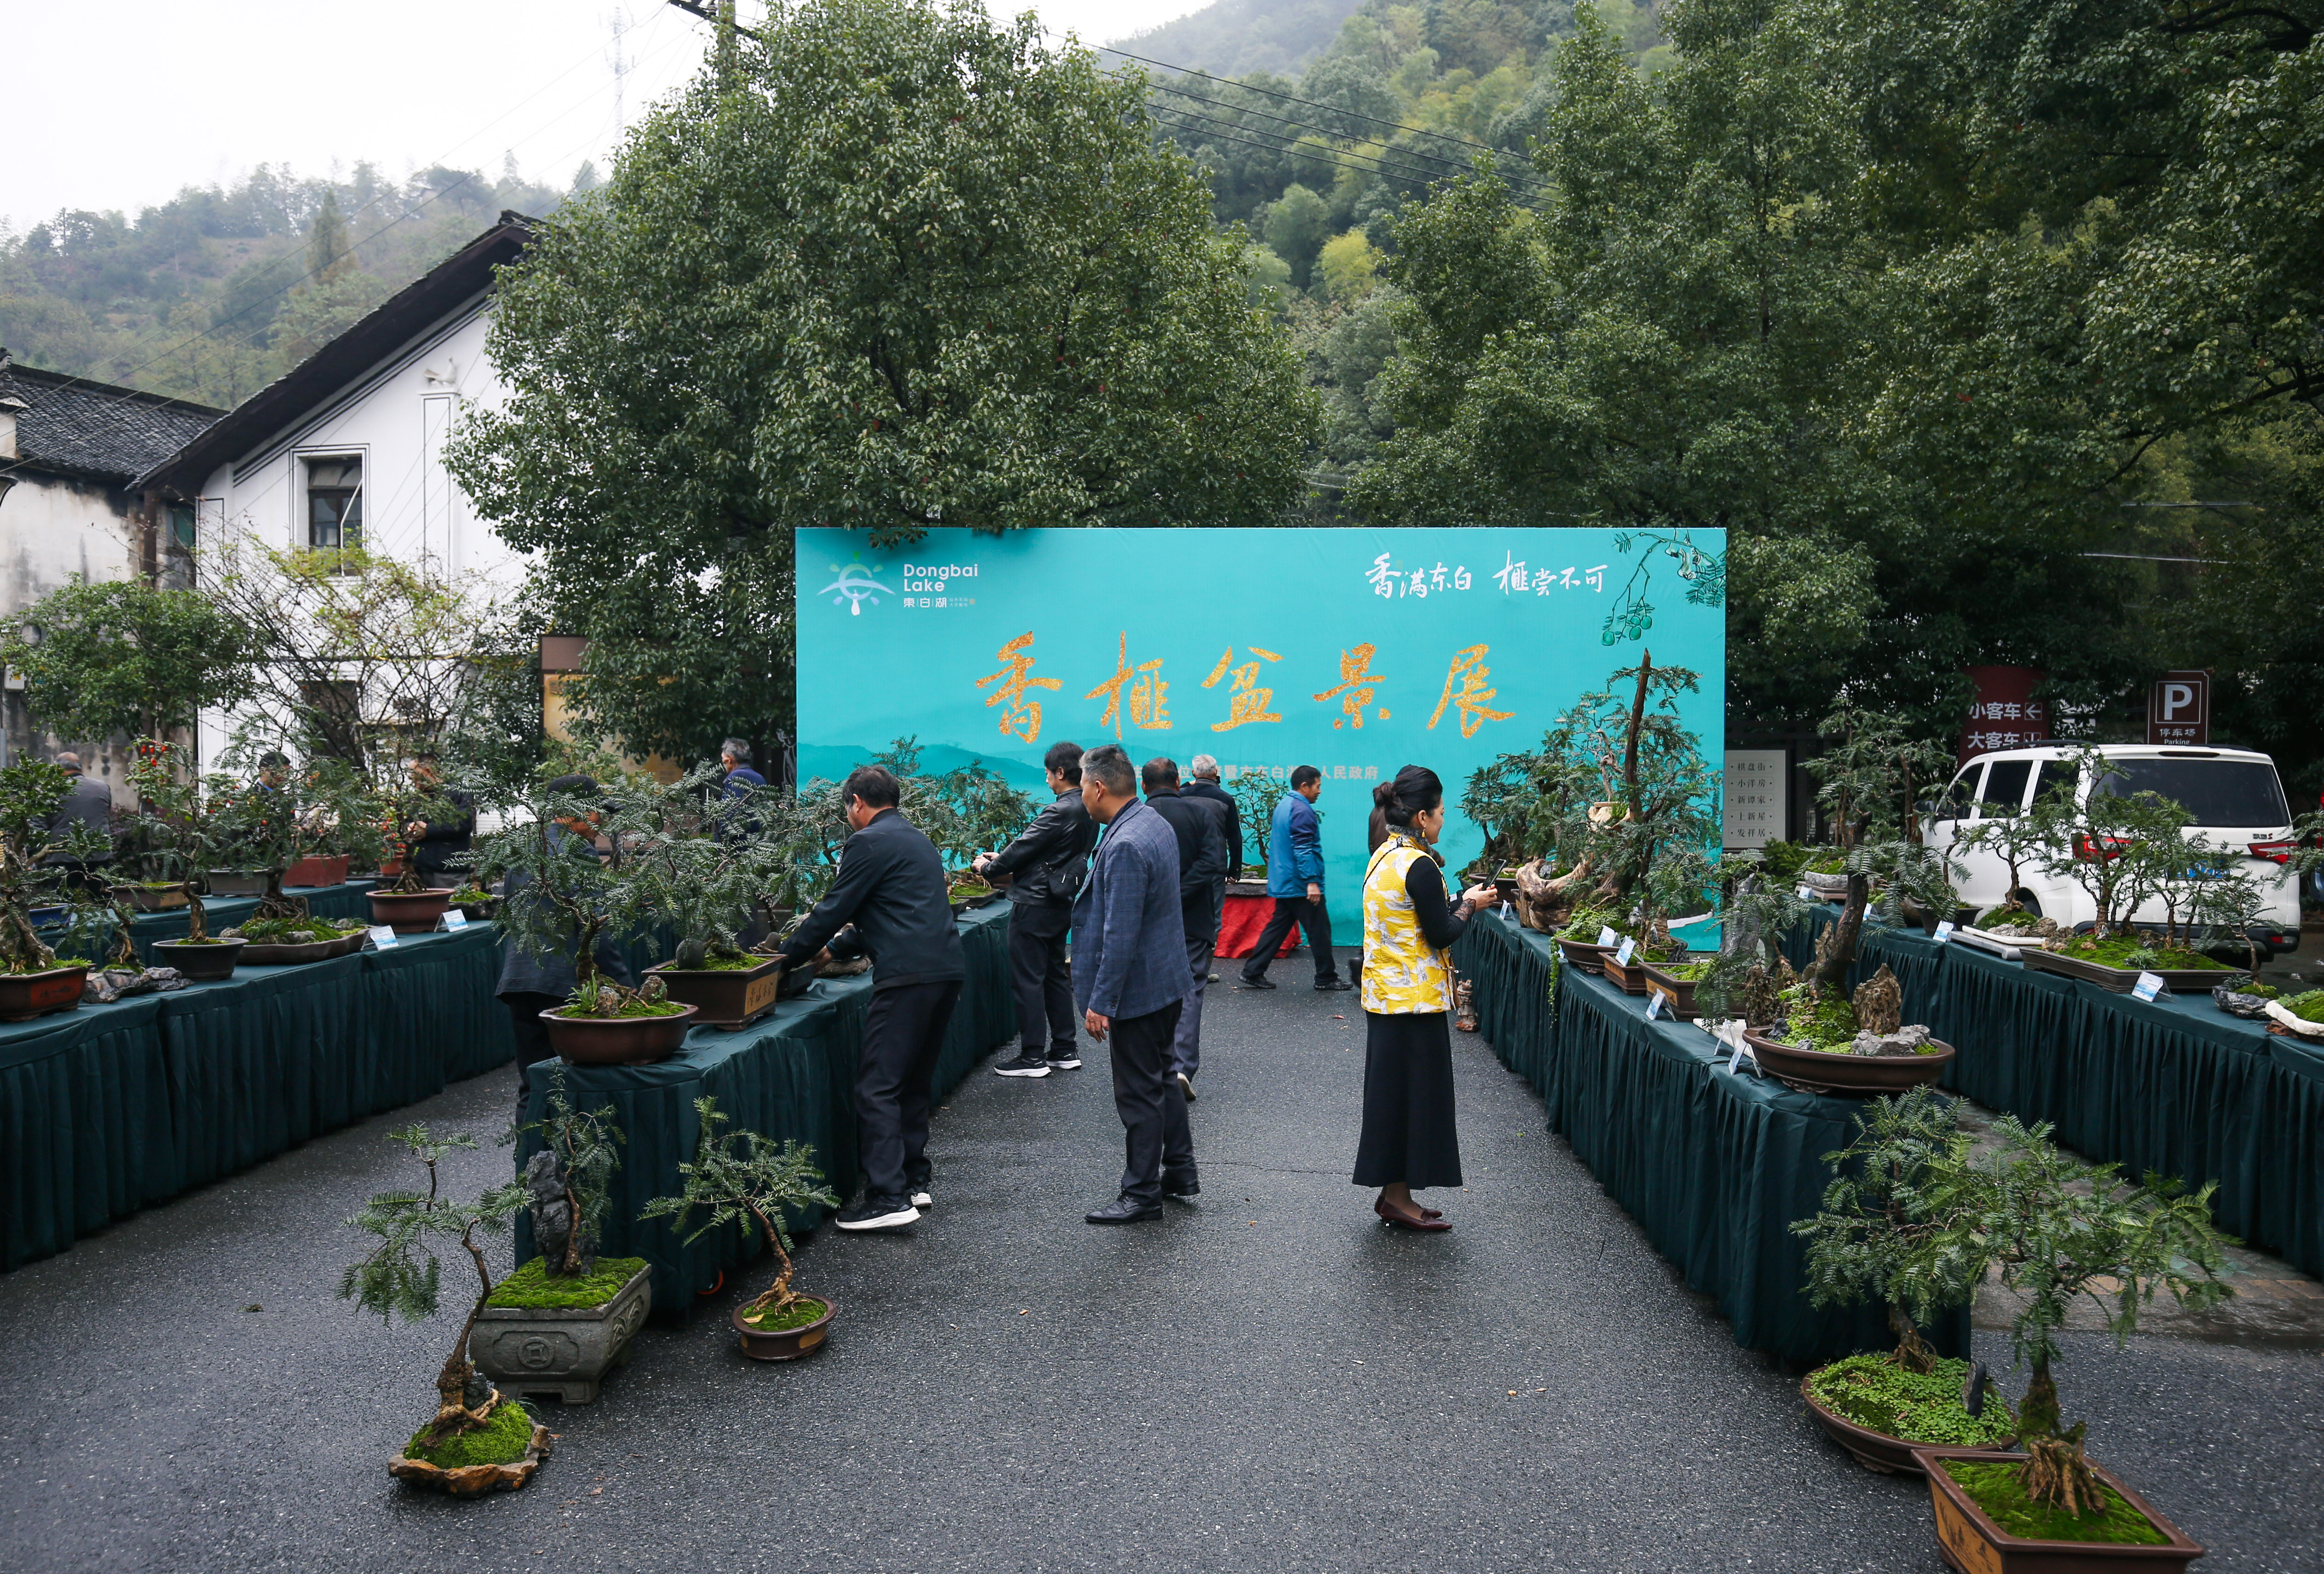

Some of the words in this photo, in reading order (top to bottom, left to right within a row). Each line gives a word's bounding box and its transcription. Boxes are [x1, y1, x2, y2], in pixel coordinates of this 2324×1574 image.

[903, 563, 978, 580] Dongbai
[1364, 552, 1472, 599] 香满东白
[903, 579, 945, 592] Lake
[975, 631, 1515, 744] 香榧盆景展
[2164, 684, 2193, 720] P
[1969, 702, 2021, 720] 小客车
[1967, 731, 2020, 749] 大客车
[2160, 728, 2196, 737] 停车场
[1737, 762, 1766, 771] 棋盘街
[1737, 779, 1766, 788] 小洋房
[1737, 812, 1766, 821] 上新屋
[1737, 828, 1766, 838] 发祥居
